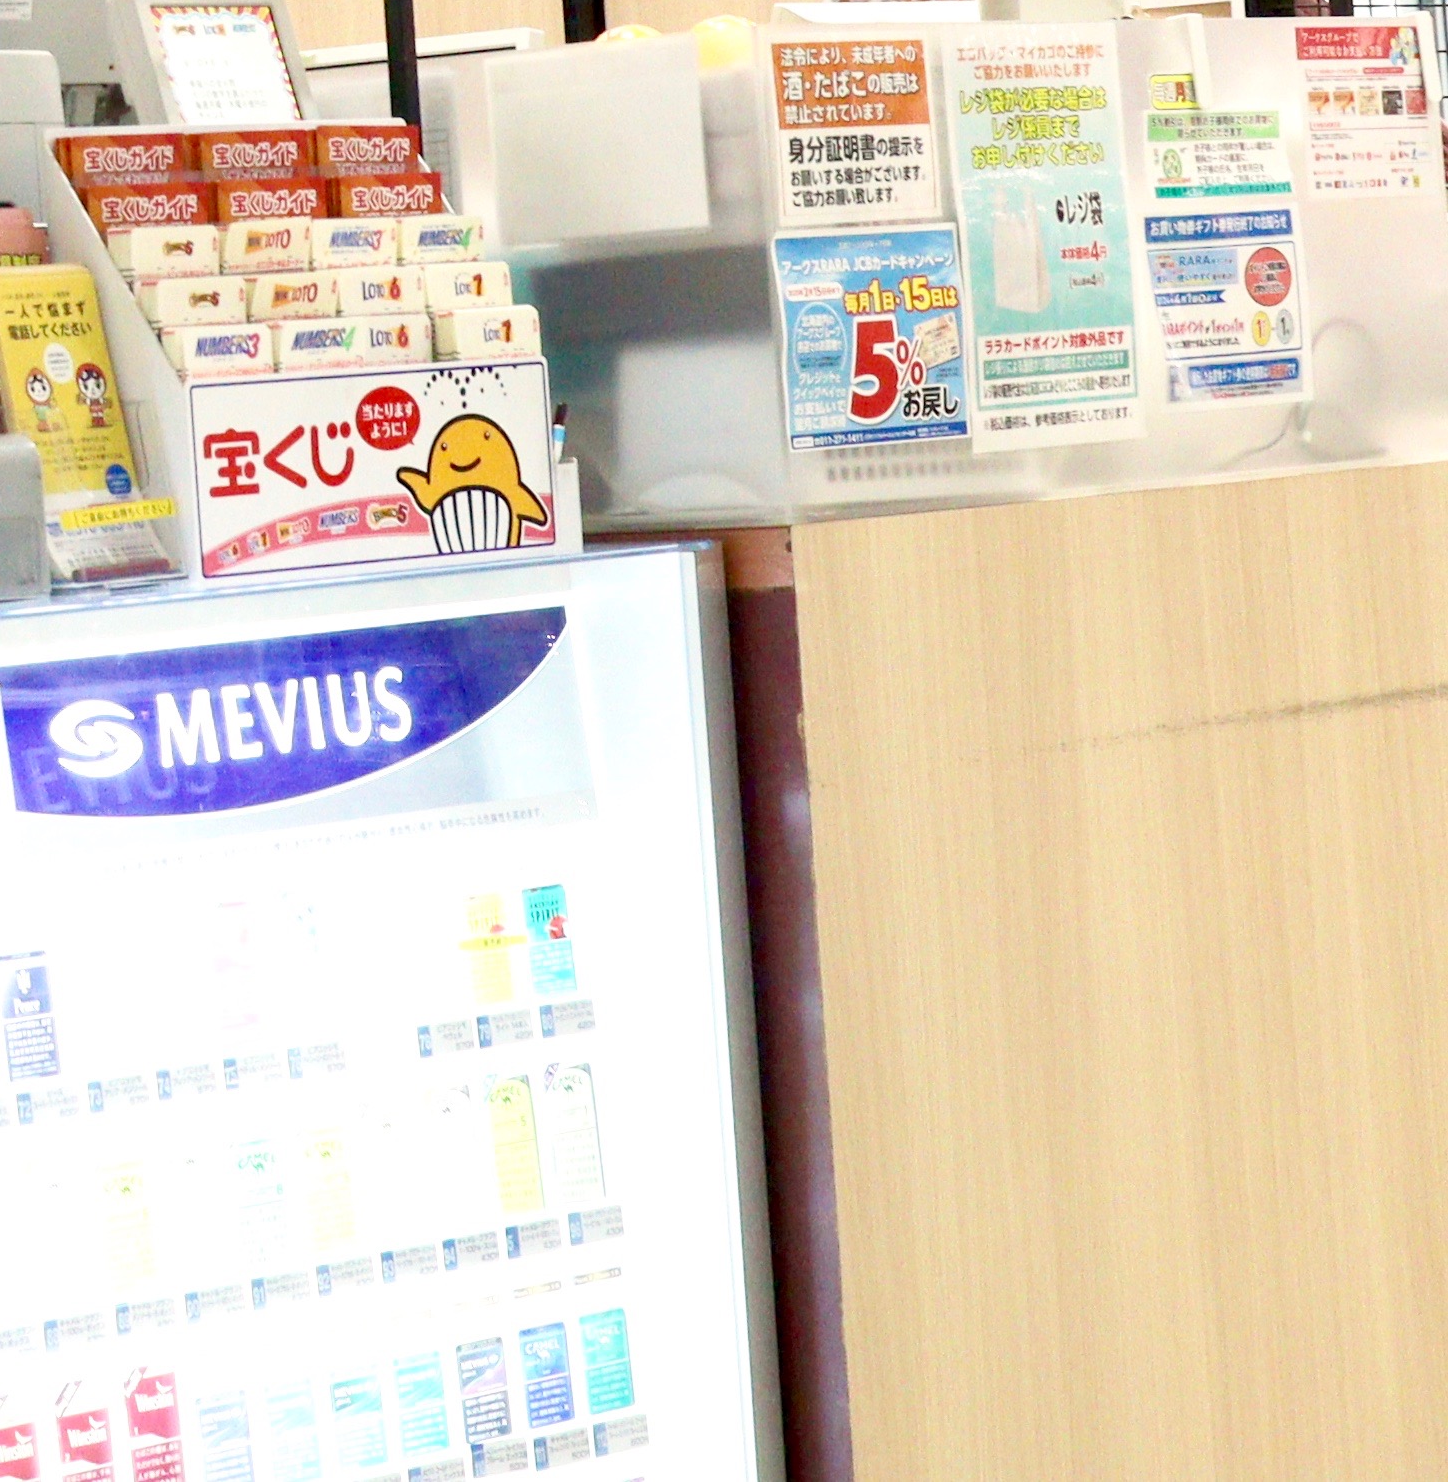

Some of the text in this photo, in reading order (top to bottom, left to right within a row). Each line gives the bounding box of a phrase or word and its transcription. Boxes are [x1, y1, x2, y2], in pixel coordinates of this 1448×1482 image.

[780, 43, 918, 66] 法令により、未成年者への
[782, 70, 920, 101] 酒・たばこの販売は
[959, 85, 1108, 114] レジ袋が必要な場合は
[784, 102, 892, 125] 禁止されています。
[992, 115, 1080, 140] レジ係員まで
[83, 143, 174, 172] 宝くじガイド
[212, 140, 299, 169] 宝くじガイド
[329, 136, 411, 163] 宝くじガイド
[788, 134, 925, 164] 身分証明書の提示を
[970, 141, 1106, 170] お申し付けください
[791, 165, 926, 187] お願いする場合がございます。
[102, 193, 198, 223] 宝くじガイド
[230, 188, 318, 216] 宝くじガイド
[351, 184, 434, 212] 宝くじガイド
[5, 299, 86, 318] 一人で悩まず
[7, 321, 92, 340] 電話してください
[195, 335, 261, 359] NUMBERS3
[847, 316, 927, 424] 5%
[361, 401, 414, 422] 当たります
[902, 384, 960, 420] お戻し
[369, 422, 408, 441] ように!
[203, 421, 355, 498] 宝くじ
[156, 665, 415, 768] MEVIUS
